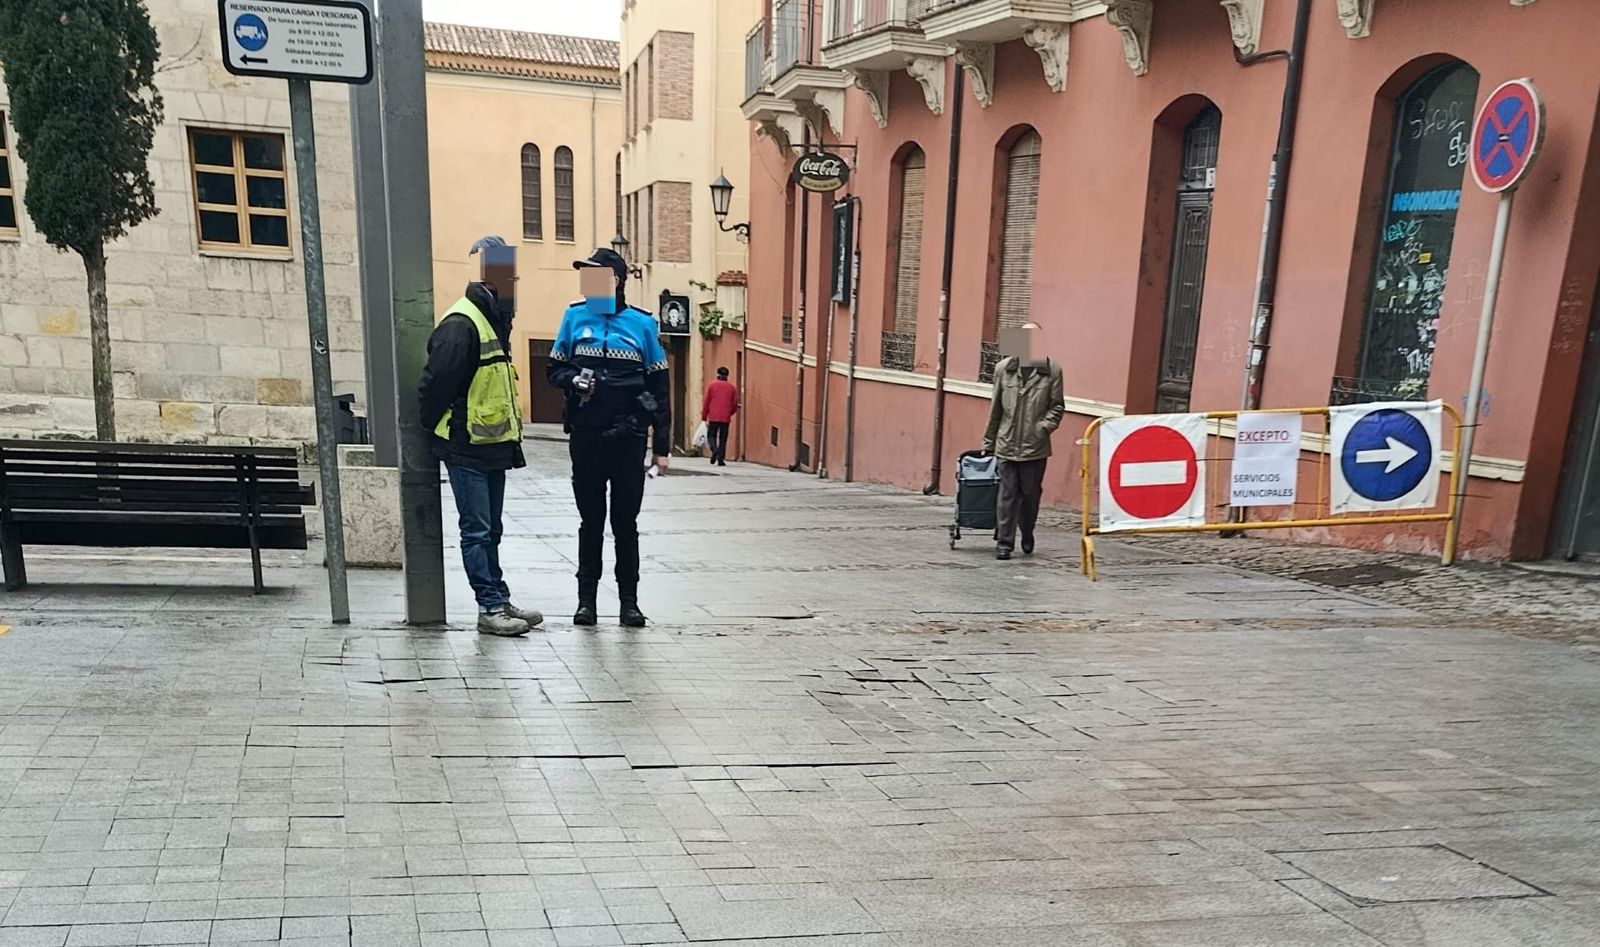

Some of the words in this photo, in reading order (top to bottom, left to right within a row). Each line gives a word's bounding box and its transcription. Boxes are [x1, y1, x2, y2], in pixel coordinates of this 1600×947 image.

[230, 4, 271, 13] RESERVADO
[291, 8, 315, 16] CARGA
[321, 10, 358, 20] DESCARGA
[324, 20, 357, 29] laborables
[312, 50, 344, 58] laborables
[1233, 473, 1281, 483] SERVICIOS
[1233, 488, 1293, 498] MUNICIPALES
